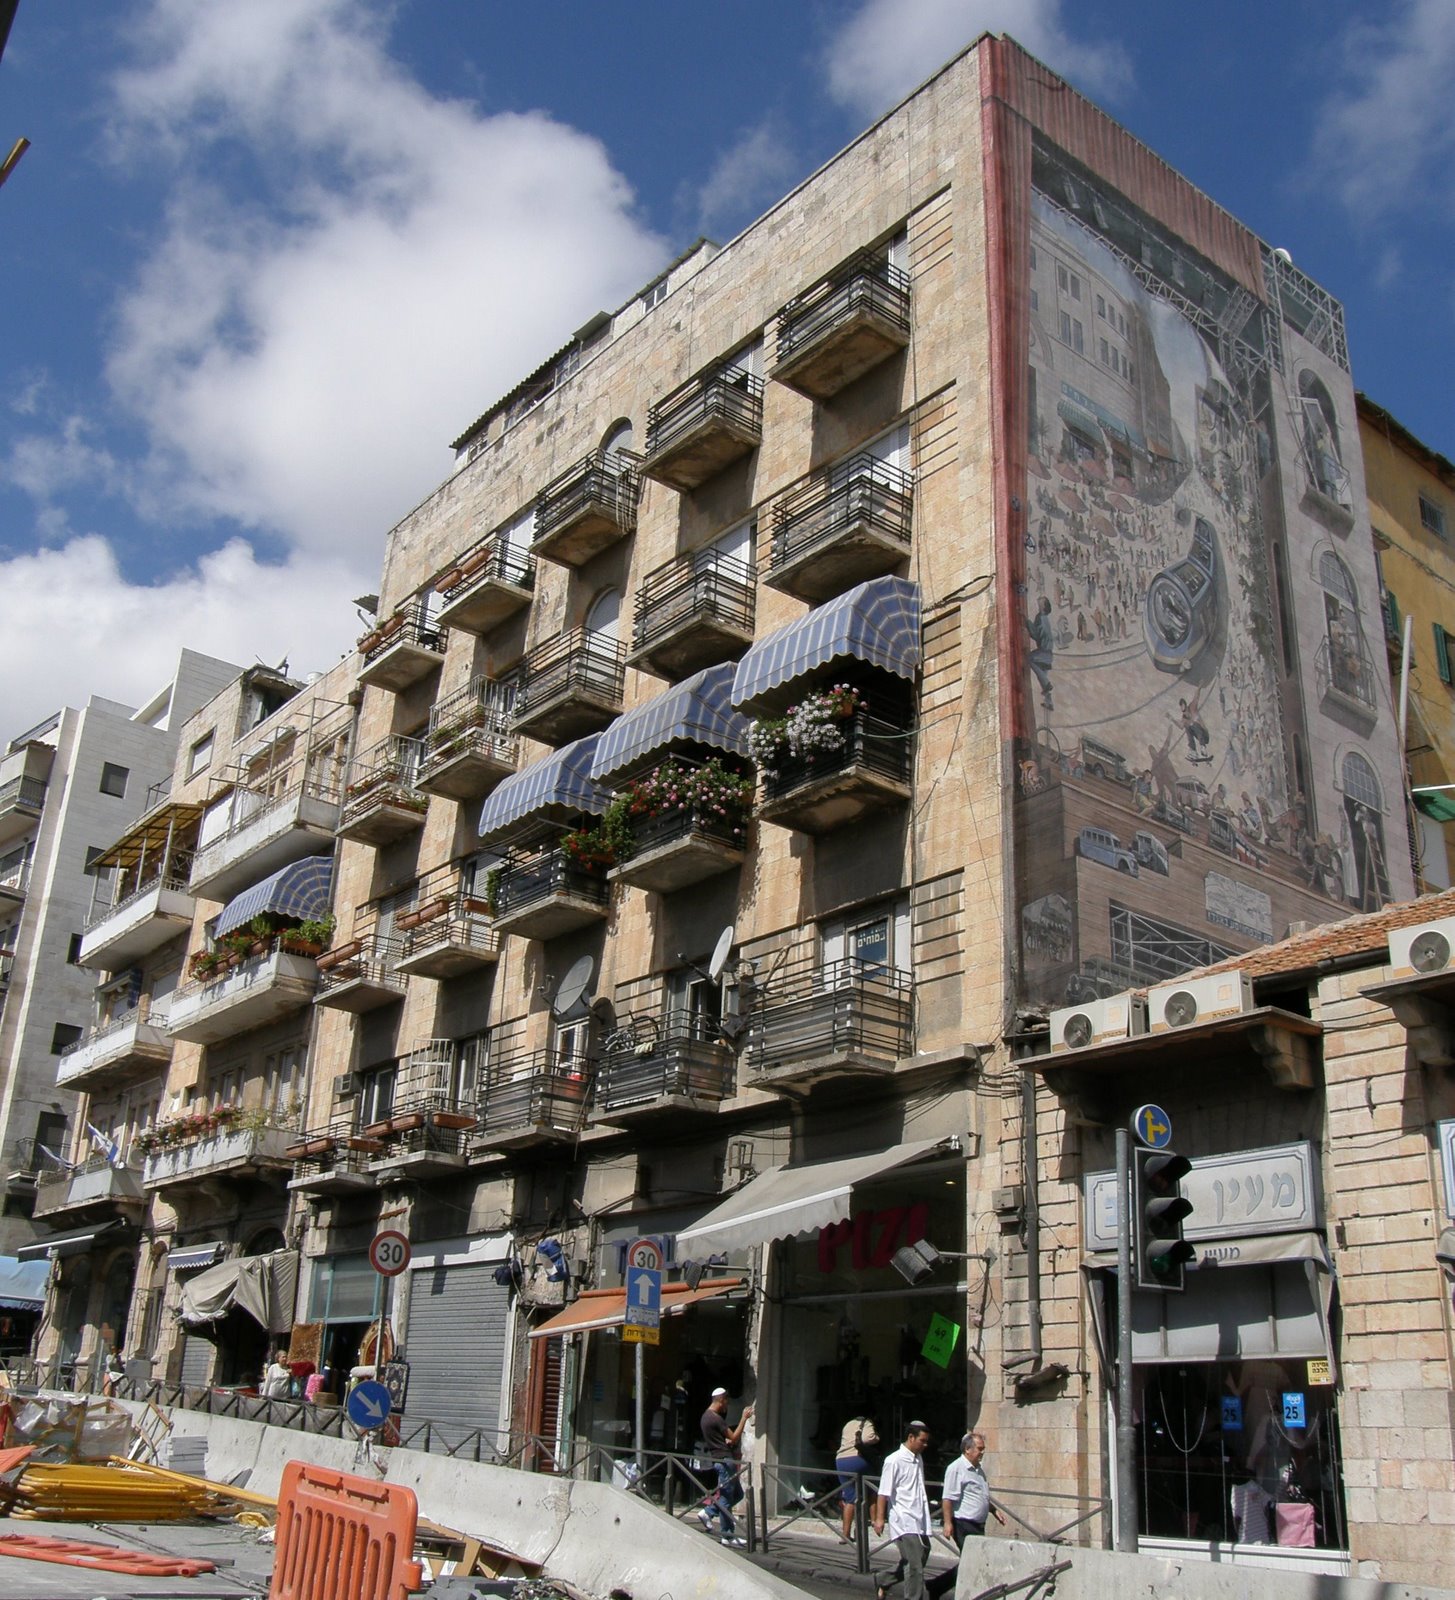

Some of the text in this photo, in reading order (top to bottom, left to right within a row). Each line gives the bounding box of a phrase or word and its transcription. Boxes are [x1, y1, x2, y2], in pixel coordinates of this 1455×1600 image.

[1212, 1172, 1296, 1224] מעין
[379, 1242, 403, 1264] 30
[637, 1251, 656, 1269] 30
[1223, 1408, 1237, 1421] 25
[1285, 1406, 1299, 1419] 25
